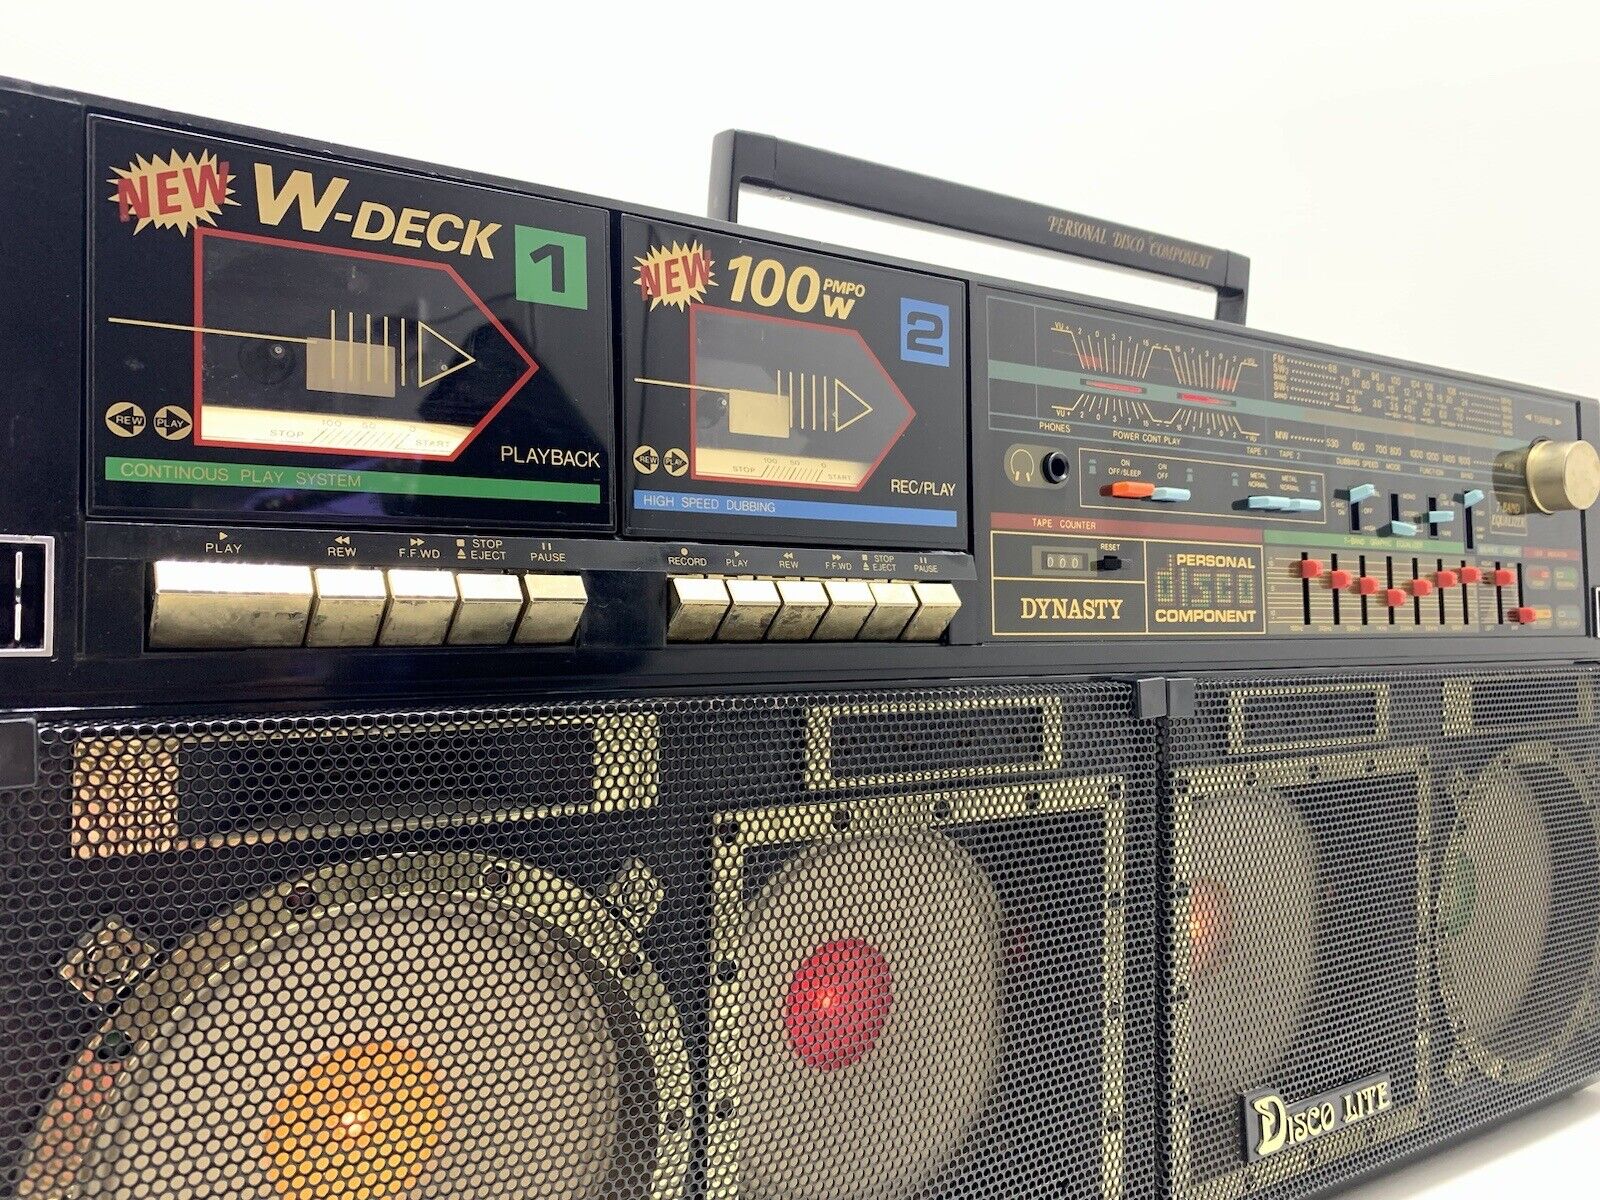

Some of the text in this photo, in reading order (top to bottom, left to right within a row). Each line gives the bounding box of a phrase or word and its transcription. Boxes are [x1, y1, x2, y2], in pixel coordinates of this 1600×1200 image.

[117, 162, 231, 222] NEW
[254, 163, 502, 260] W-DECK
[1048, 216, 1213, 270] PERSONAL DISCO COMPONENT
[530, 243, 566, 294] 1
[640, 250, 711, 302] NEW
[727, 255, 821, 313] 100
[823, 278, 866, 298] PMPO
[823, 294, 856, 321] W
[906, 311, 944, 356] 2
[115, 415, 143, 425] REW
[156, 418, 184, 428] PLAY
[321, 419, 342, 428] 100
[1039, 421, 1071, 433] PHONES
[270, 429, 304, 438] STOP
[1112, 430, 1140, 441] POWER
[1142, 433, 1181, 445] CONT PLAY
[1274, 430, 1289, 441] MW
[415, 439, 450, 448] START
[1246, 446, 1262, 456] TAPE
[1279, 449, 1294, 459] TAPE
[501, 445, 601, 469] PLAYBACK
[763, 457, 778, 465] 100
[1120, 458, 1130, 467] ON
[732, 465, 756, 473] STOP
[1108, 467, 1142, 477] OFF/SLEEP
[121, 463, 361, 488] CONTINOUS PLAY SYSTEM
[828, 473, 852, 481] START
[891, 479, 956, 497] REC/PLAY
[643, 494, 776, 513] HIGH SPEED DUBBING
[1032, 518, 1096, 530] TAPE COUNTER
[205, 542, 242, 554] PLAY
[472, 539, 503, 550] STOP
[1100, 543, 1121, 551] RESET
[327, 546, 357, 557] REW
[398, 548, 441, 559] F.F.WD
[471, 550, 507, 561] EJECT
[530, 551, 566, 563] PAUSE
[668, 556, 708, 567] RECORD
[725, 558, 749, 568] PLAY
[873, 554, 894, 563] STOP
[1176, 554, 1256, 569] PERSONAL
[779, 560, 799, 569] REW
[872, 562, 897, 572] EJECT
[914, 563, 939, 573] PAUSE
[1020, 598, 1123, 620] DYNASTY
[1155, 609, 1256, 623] COMPONENT
[1343, 1081, 1390, 1123] LITE
